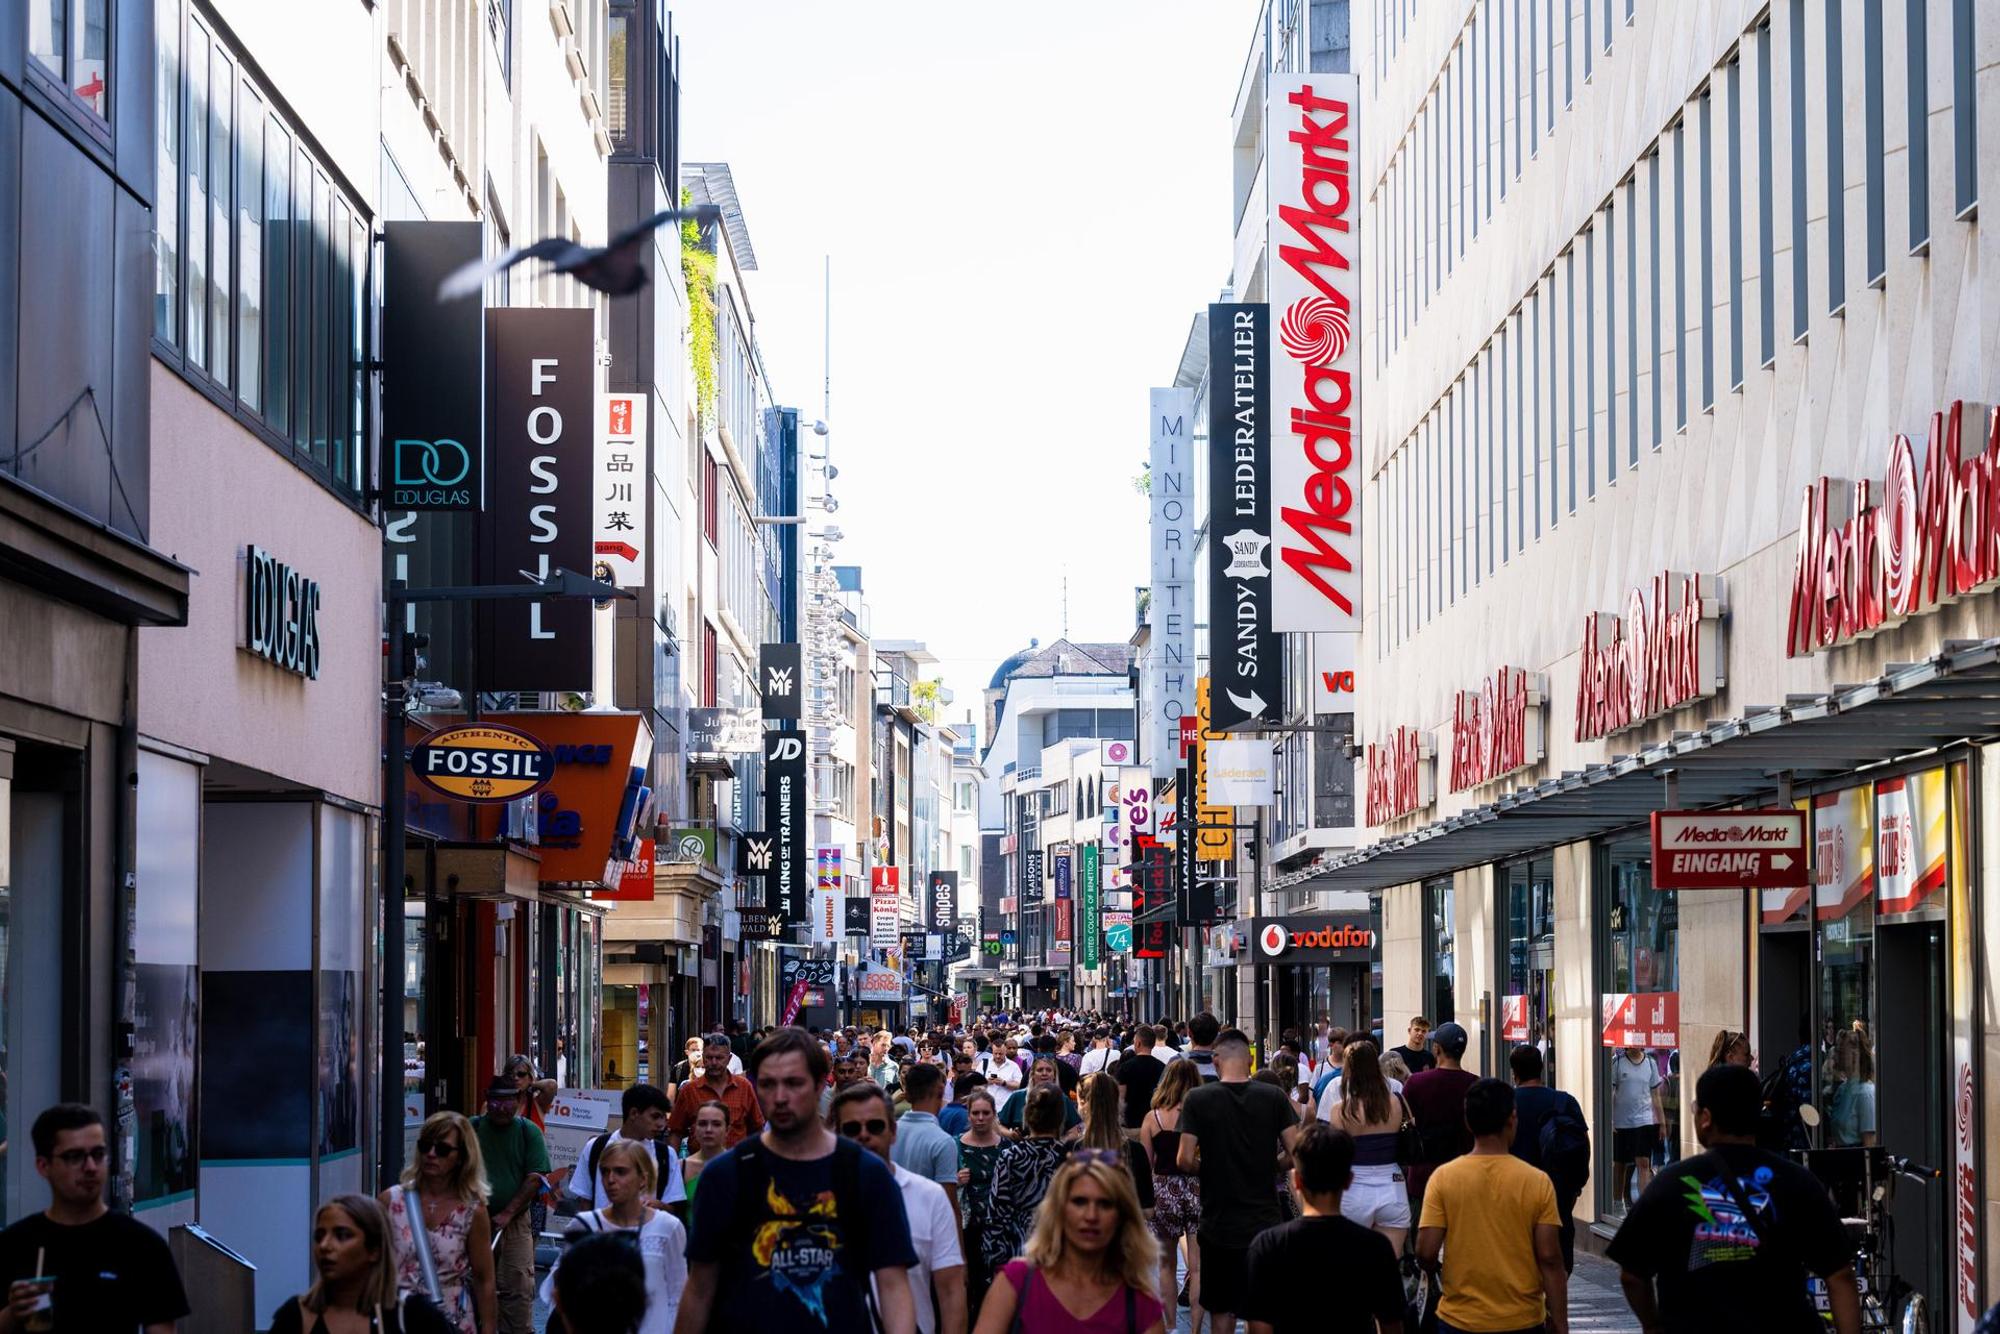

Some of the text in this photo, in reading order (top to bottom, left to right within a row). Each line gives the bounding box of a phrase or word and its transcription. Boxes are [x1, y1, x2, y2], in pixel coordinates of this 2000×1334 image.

[394, 489, 470, 505] DOUGLAS
[527, 358, 563, 639] FOSSIL
[604, 440, 635, 532] 一品川菜
[1234, 311, 1258, 678] SANDY LEDERATELIER
[1234, 541, 1260, 555] SANDY
[1162, 416, 1184, 750] MINORITENHOF
[246, 544, 320, 680] DOUGLAS
[440, 730, 529, 749] AUTHENTIC
[769, 738, 802, 760] JD
[427, 749, 540, 777] FOSSIL
[780, 775, 791, 845] TRAINERS
[1672, 852, 1761, 874] EINGANG
[780, 861, 791, 894] KING
[873, 905, 898, 914] König
[935, 883, 954, 927] snipes
[1087, 893, 1095, 904] OF
[825, 896, 834, 938] DUNKIN'
[1087, 905, 1095, 935] COLORS
[1087, 936, 1095, 961] UNITED
[861, 981, 900, 992] LOUNGE
[866, 973, 896, 983] FOOD
[771, 1247, 834, 1270] ALL-STAR
